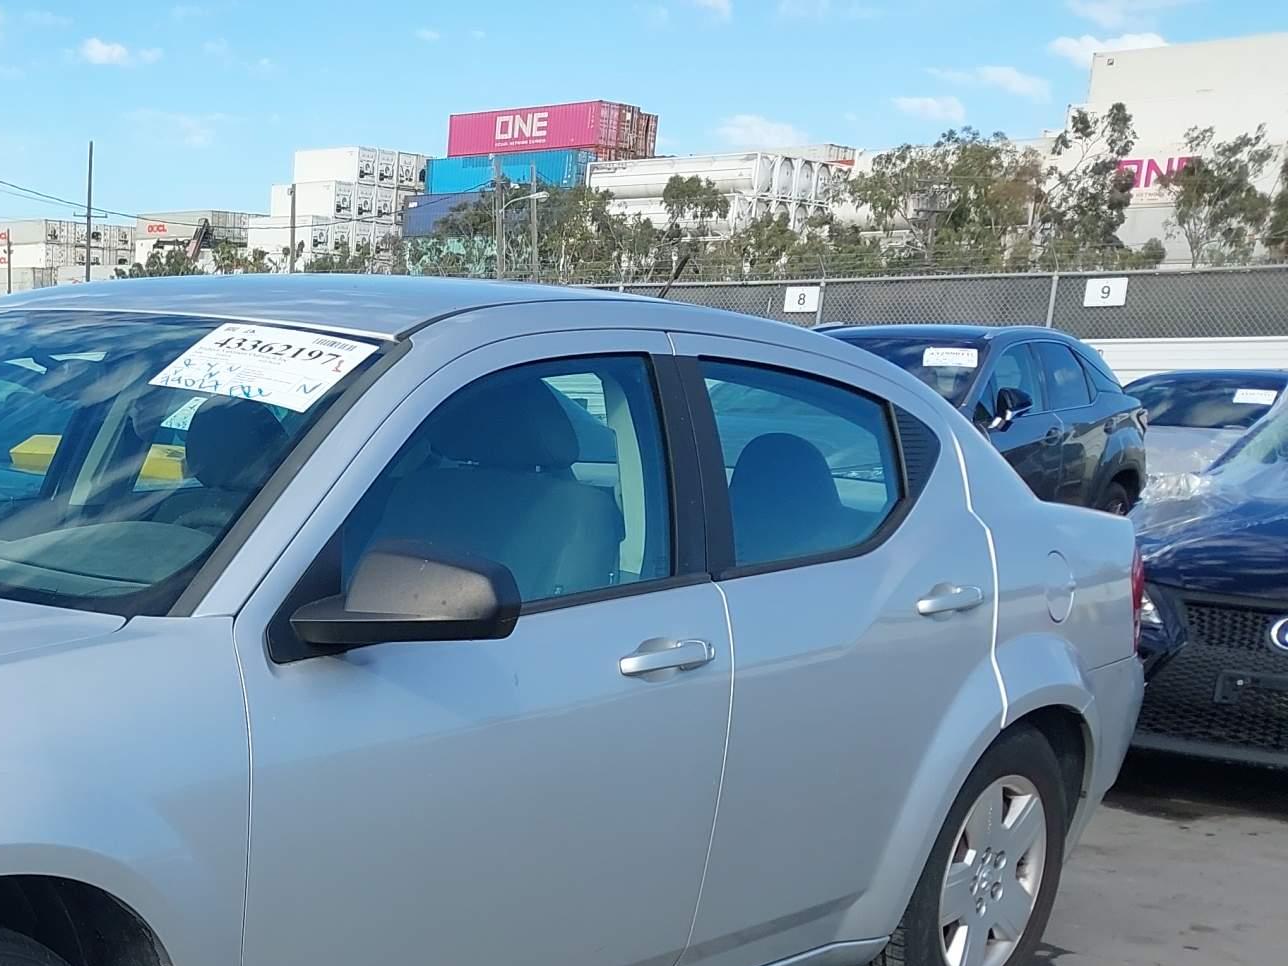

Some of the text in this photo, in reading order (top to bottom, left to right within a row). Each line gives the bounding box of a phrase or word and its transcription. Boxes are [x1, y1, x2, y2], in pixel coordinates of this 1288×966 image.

[495, 112, 549, 140] ONE
[797, 293, 806, 306] 8
[1100, 285, 1111, 299] 9
[214, 336, 343, 365] 43362197
